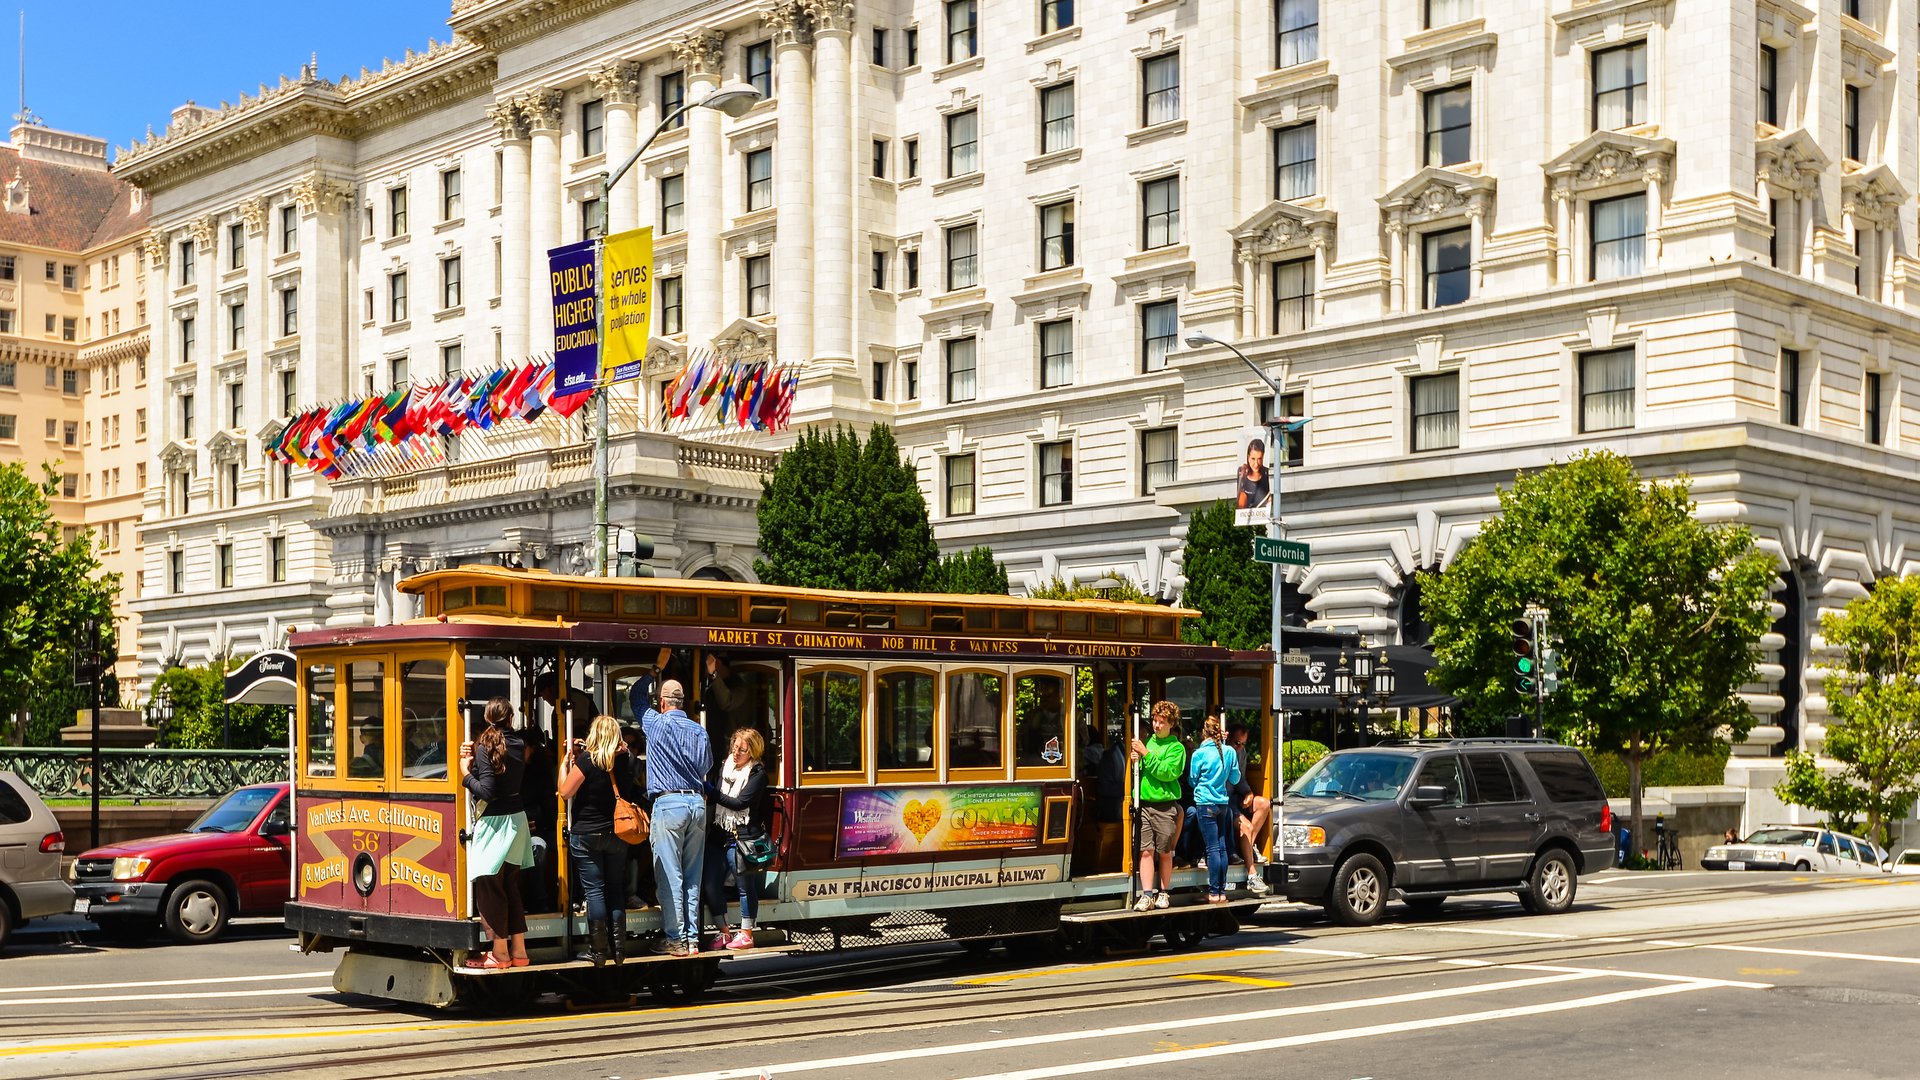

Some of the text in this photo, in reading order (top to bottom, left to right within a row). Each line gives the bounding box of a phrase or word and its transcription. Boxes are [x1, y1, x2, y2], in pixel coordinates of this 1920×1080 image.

[552, 263, 593, 296] PUBLIC
[611, 265, 647, 289] serves
[610, 289, 647, 310] the whole
[555, 297, 595, 328] HIGHER
[610, 311, 645, 332] population
[556, 328, 598, 352] EDUCATION
[564, 372, 586, 387] sfsu.edu
[1260, 543, 1305, 561] California
[628, 628, 649, 640] 56
[708, 630, 758, 645] MARKET
[882, 637, 904, 649] NOB
[912, 639, 937, 651] HILL
[970, 640, 988, 652] VAN
[992, 641, 1018, 653] NESS
[1068, 644, 1126, 657] CALIFORNIA
[1280, 685, 1331, 695] STAURANT
[310, 811, 324, 828] Van
[325, 807, 346, 827] Ness
[378, 807, 440, 835] California
[352, 830, 379, 852] 56
[305, 860, 444, 893] & Market Streets
[807, 868, 1046, 897] SAN FRANCISCO MUNICIPAL RAILWAY
